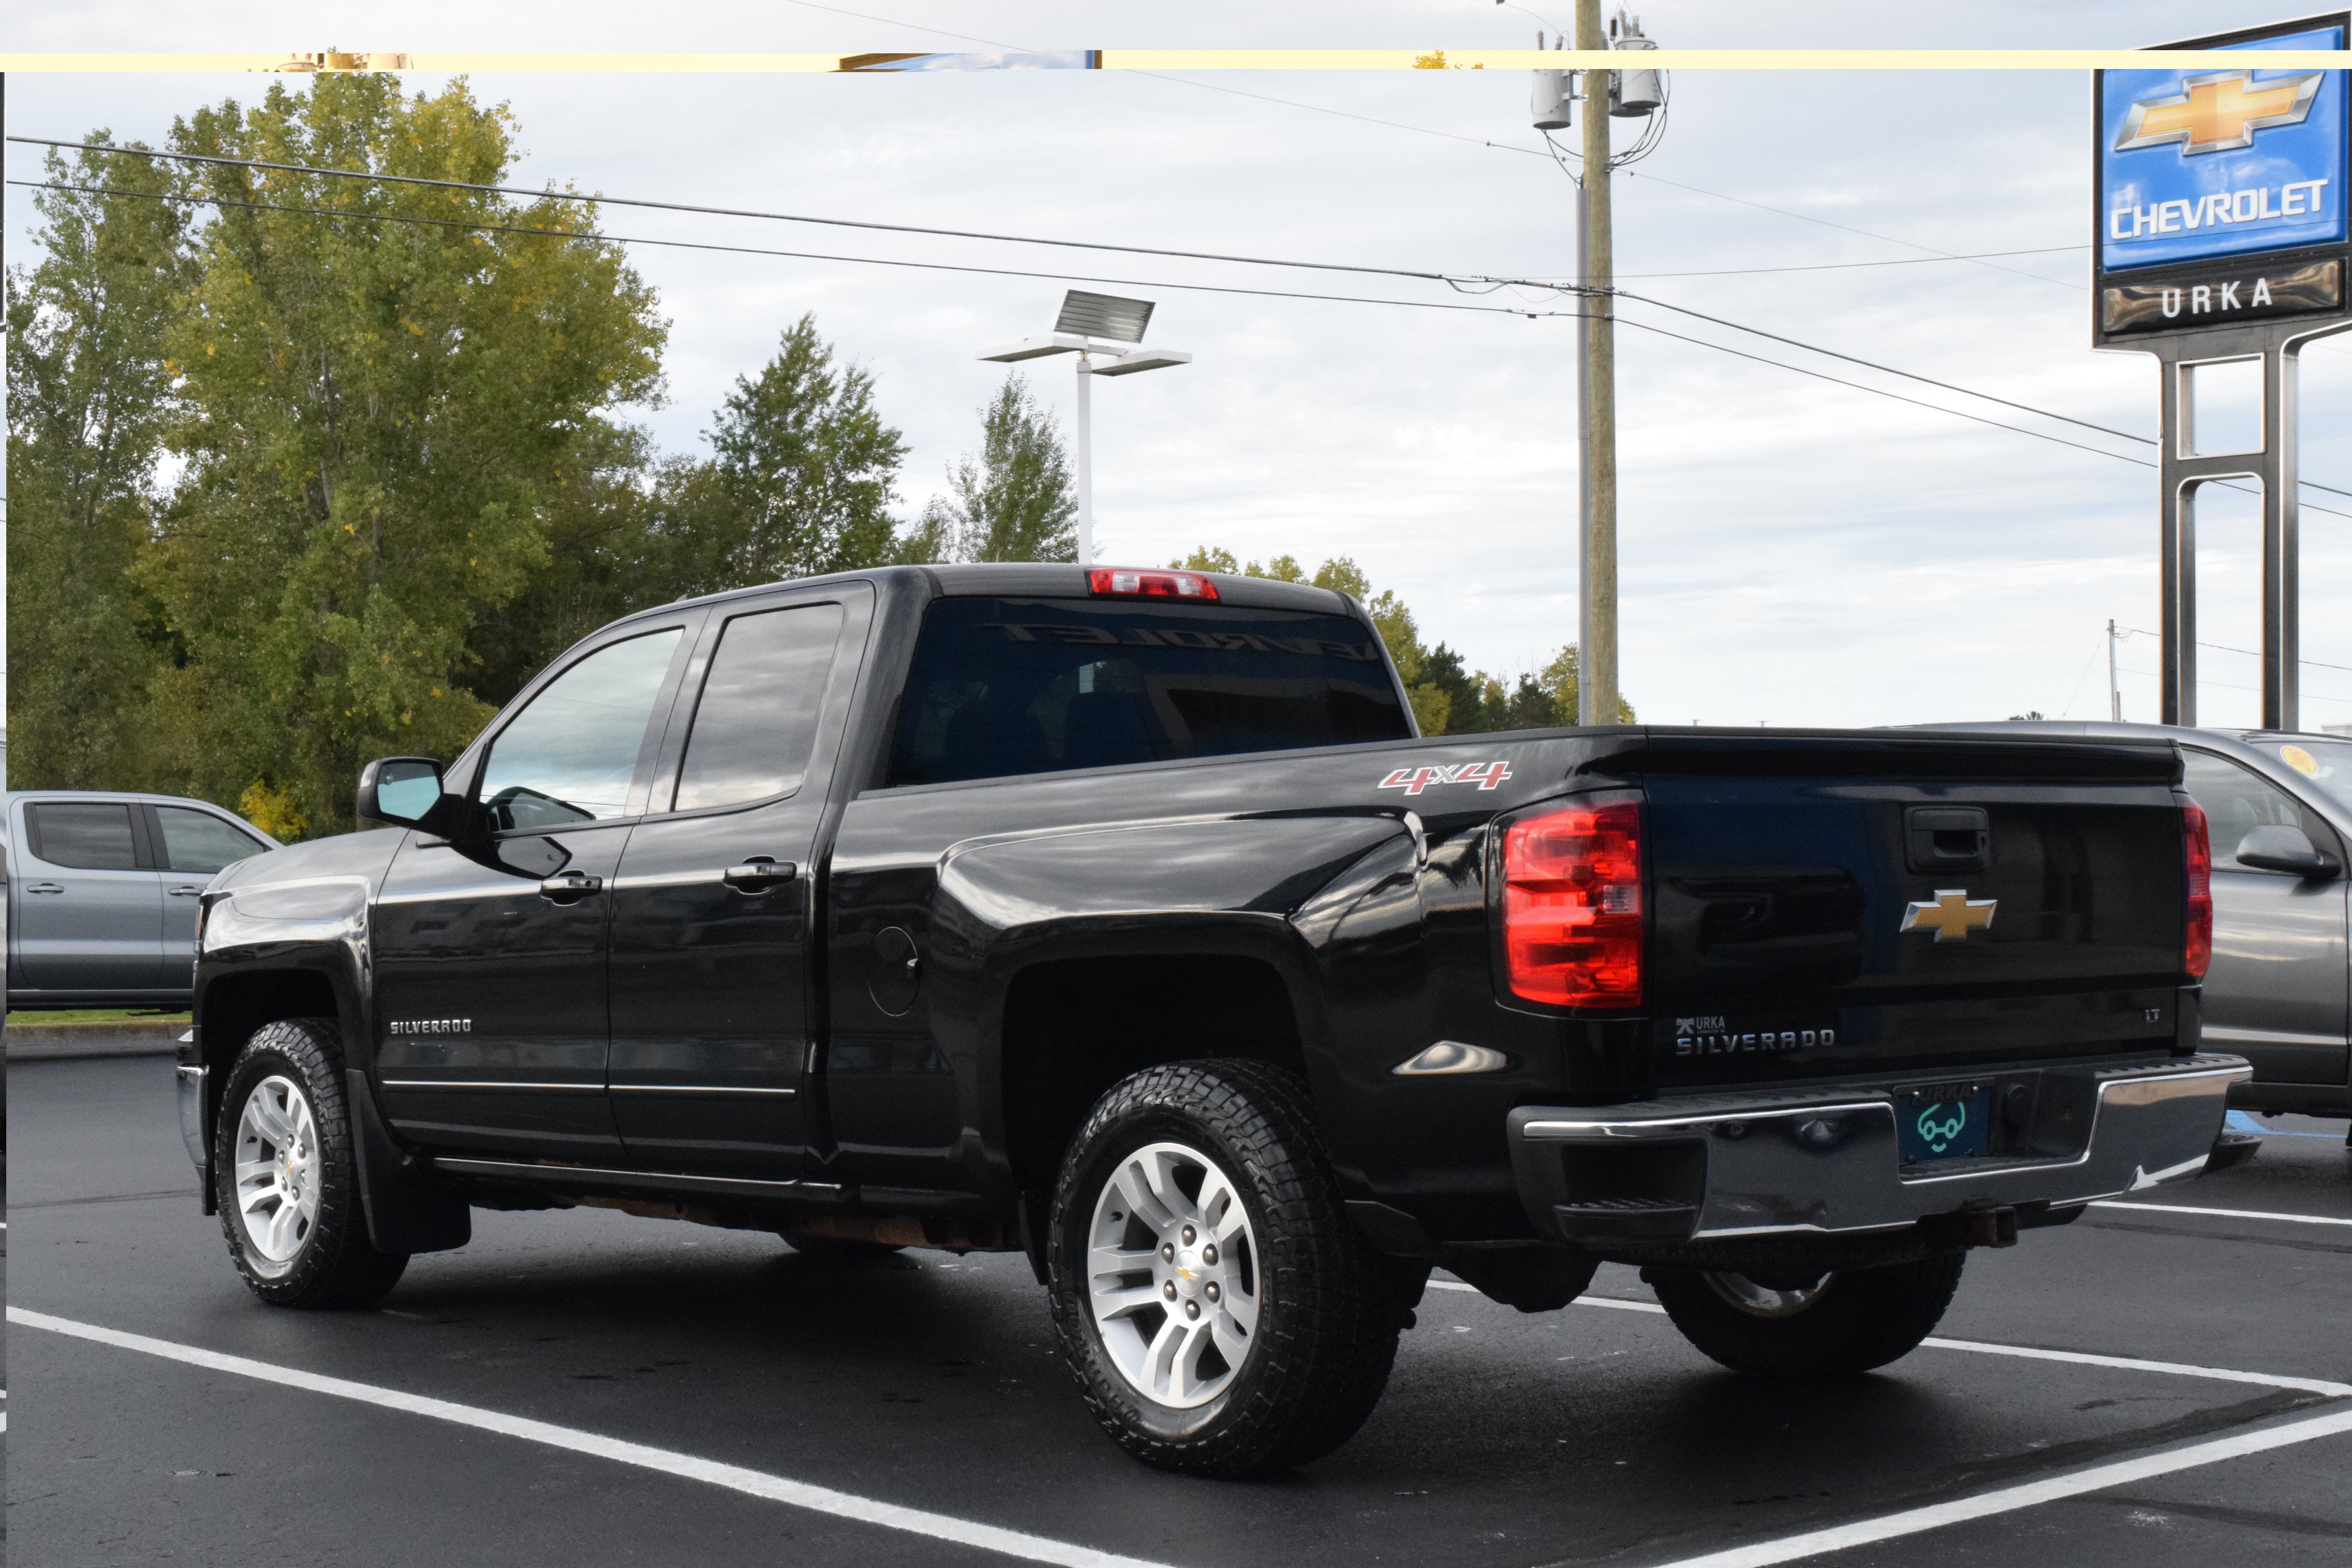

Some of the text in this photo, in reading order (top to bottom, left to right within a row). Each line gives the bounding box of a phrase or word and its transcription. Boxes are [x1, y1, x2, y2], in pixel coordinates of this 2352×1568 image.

[2111, 178, 2329, 240] CHEVROLET
[2161, 277, 2273, 318] URKA
[390, 1019, 471, 1034] SILVERADO
[1696, 1016, 1725, 1029] URKA
[2145, 1009, 2160, 1023] LT
[1675, 1029, 1835, 1056] SILVERADO
